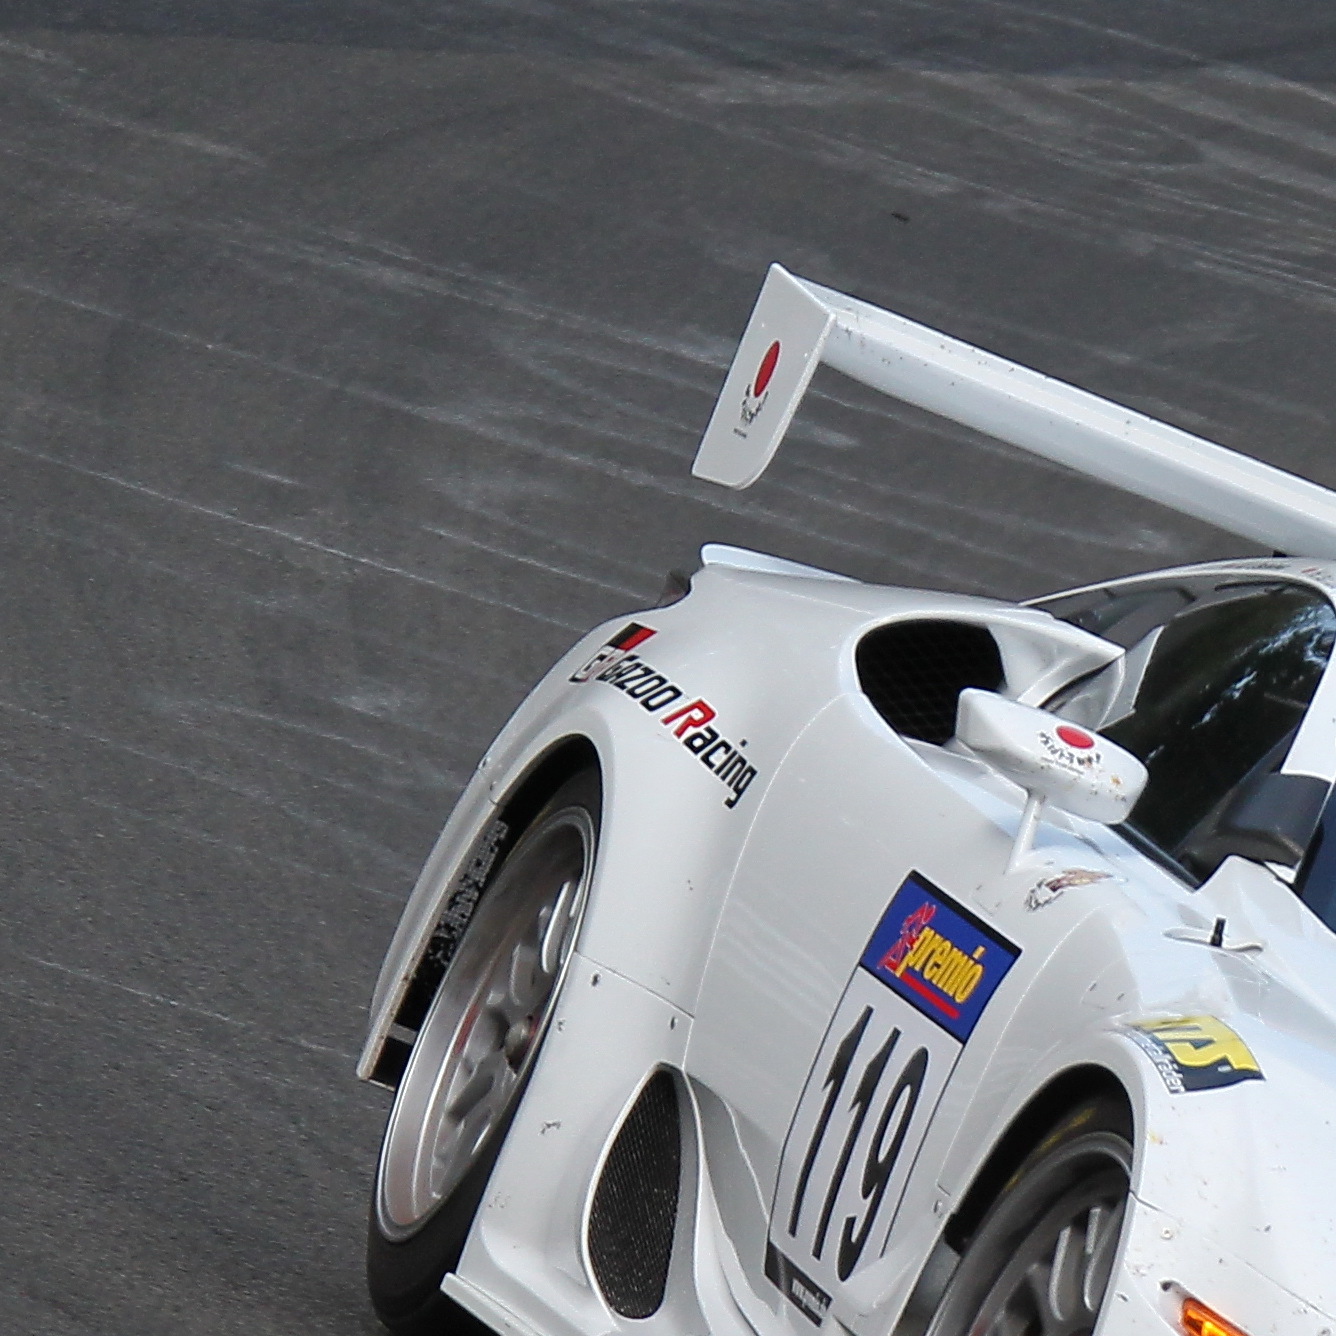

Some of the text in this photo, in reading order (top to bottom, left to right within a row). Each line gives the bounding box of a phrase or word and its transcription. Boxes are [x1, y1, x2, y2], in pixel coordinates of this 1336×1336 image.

[660, 698, 758, 810] Racing
[895, 926, 986, 1004] premio
[788, 1003, 930, 1283] 119
